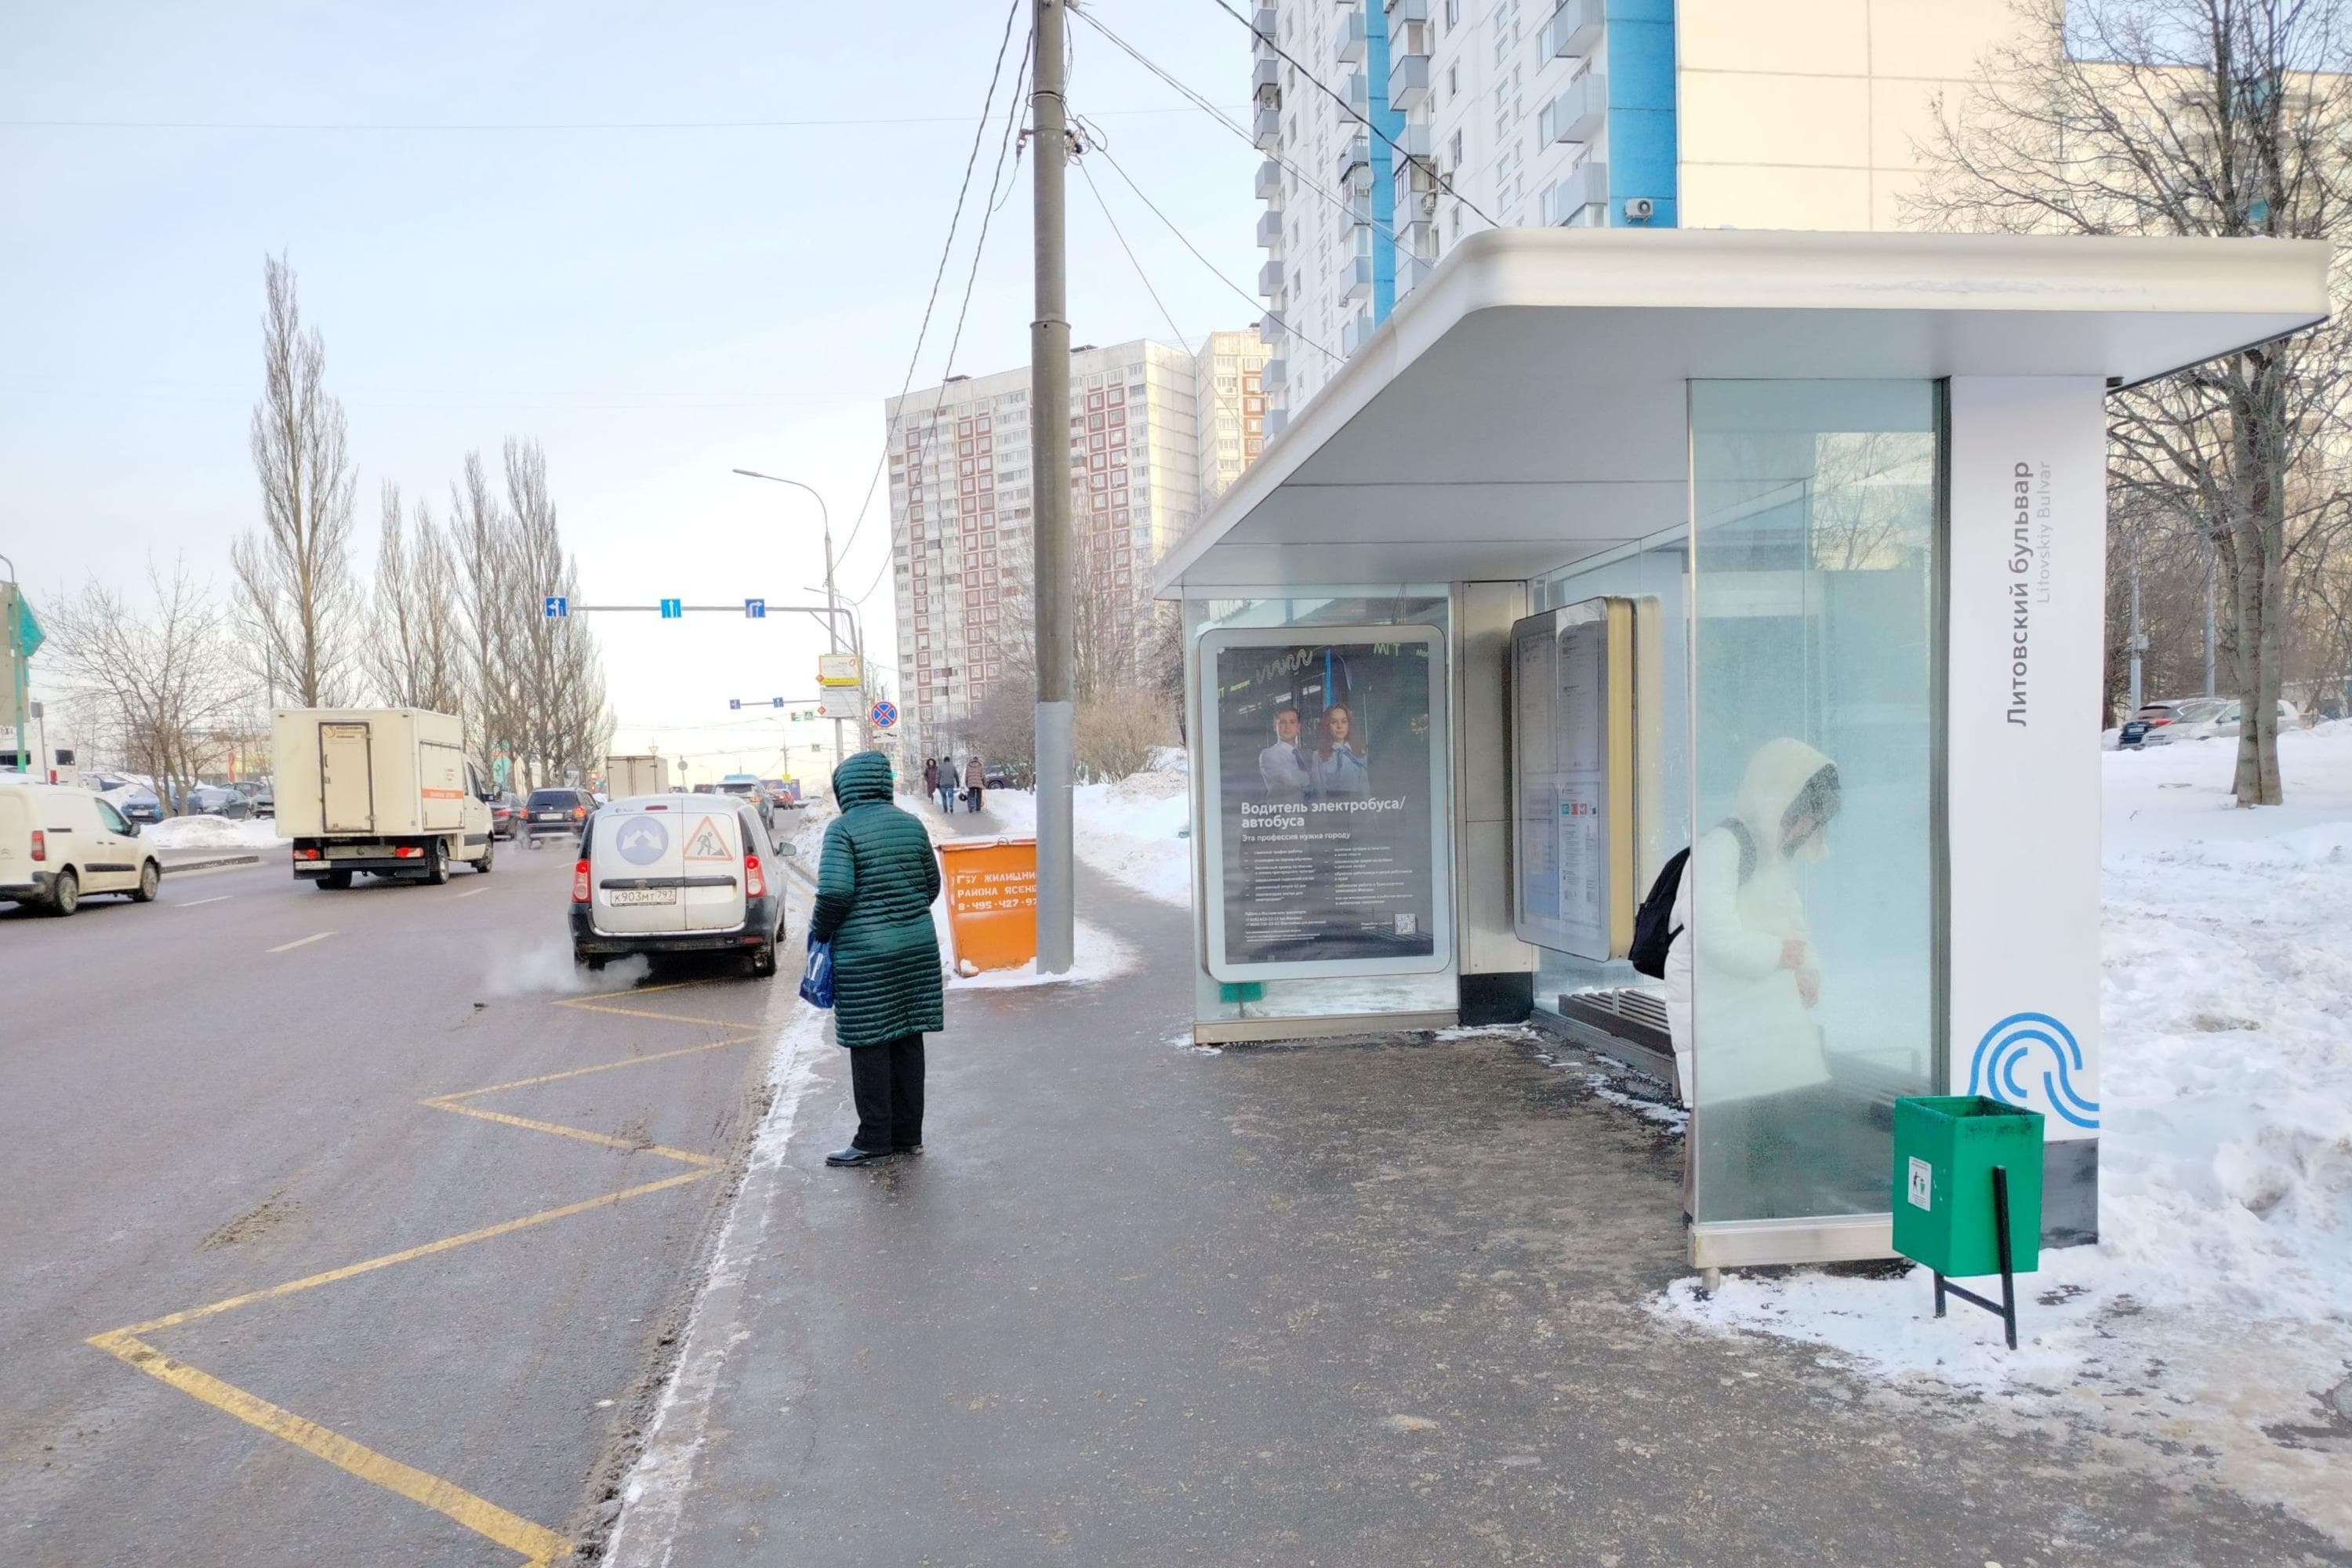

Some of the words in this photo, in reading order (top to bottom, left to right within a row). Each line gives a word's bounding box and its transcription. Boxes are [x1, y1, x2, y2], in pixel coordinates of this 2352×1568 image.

[2036, 461, 2052, 519] Bulvar
[2008, 462, 2034, 574] бульвар
[2036, 523, 2054, 603] Litovskiy
[2006, 583, 2029, 727] Литовский
[1241, 801, 1308, 816] Водитель
[1311, 795, 1406, 813] электробуса/
[1242, 815, 1305, 829] автобуса
[1242, 833, 1255, 842] Эта
[1257, 833, 1299, 843] профессия
[1299, 833, 1323, 842] нужна
[1324, 831, 1351, 840] городу
[984, 871, 1036, 883] ЖИЛИЩНИ
[1004, 884, 1037, 895] ЯСЕНЕ
